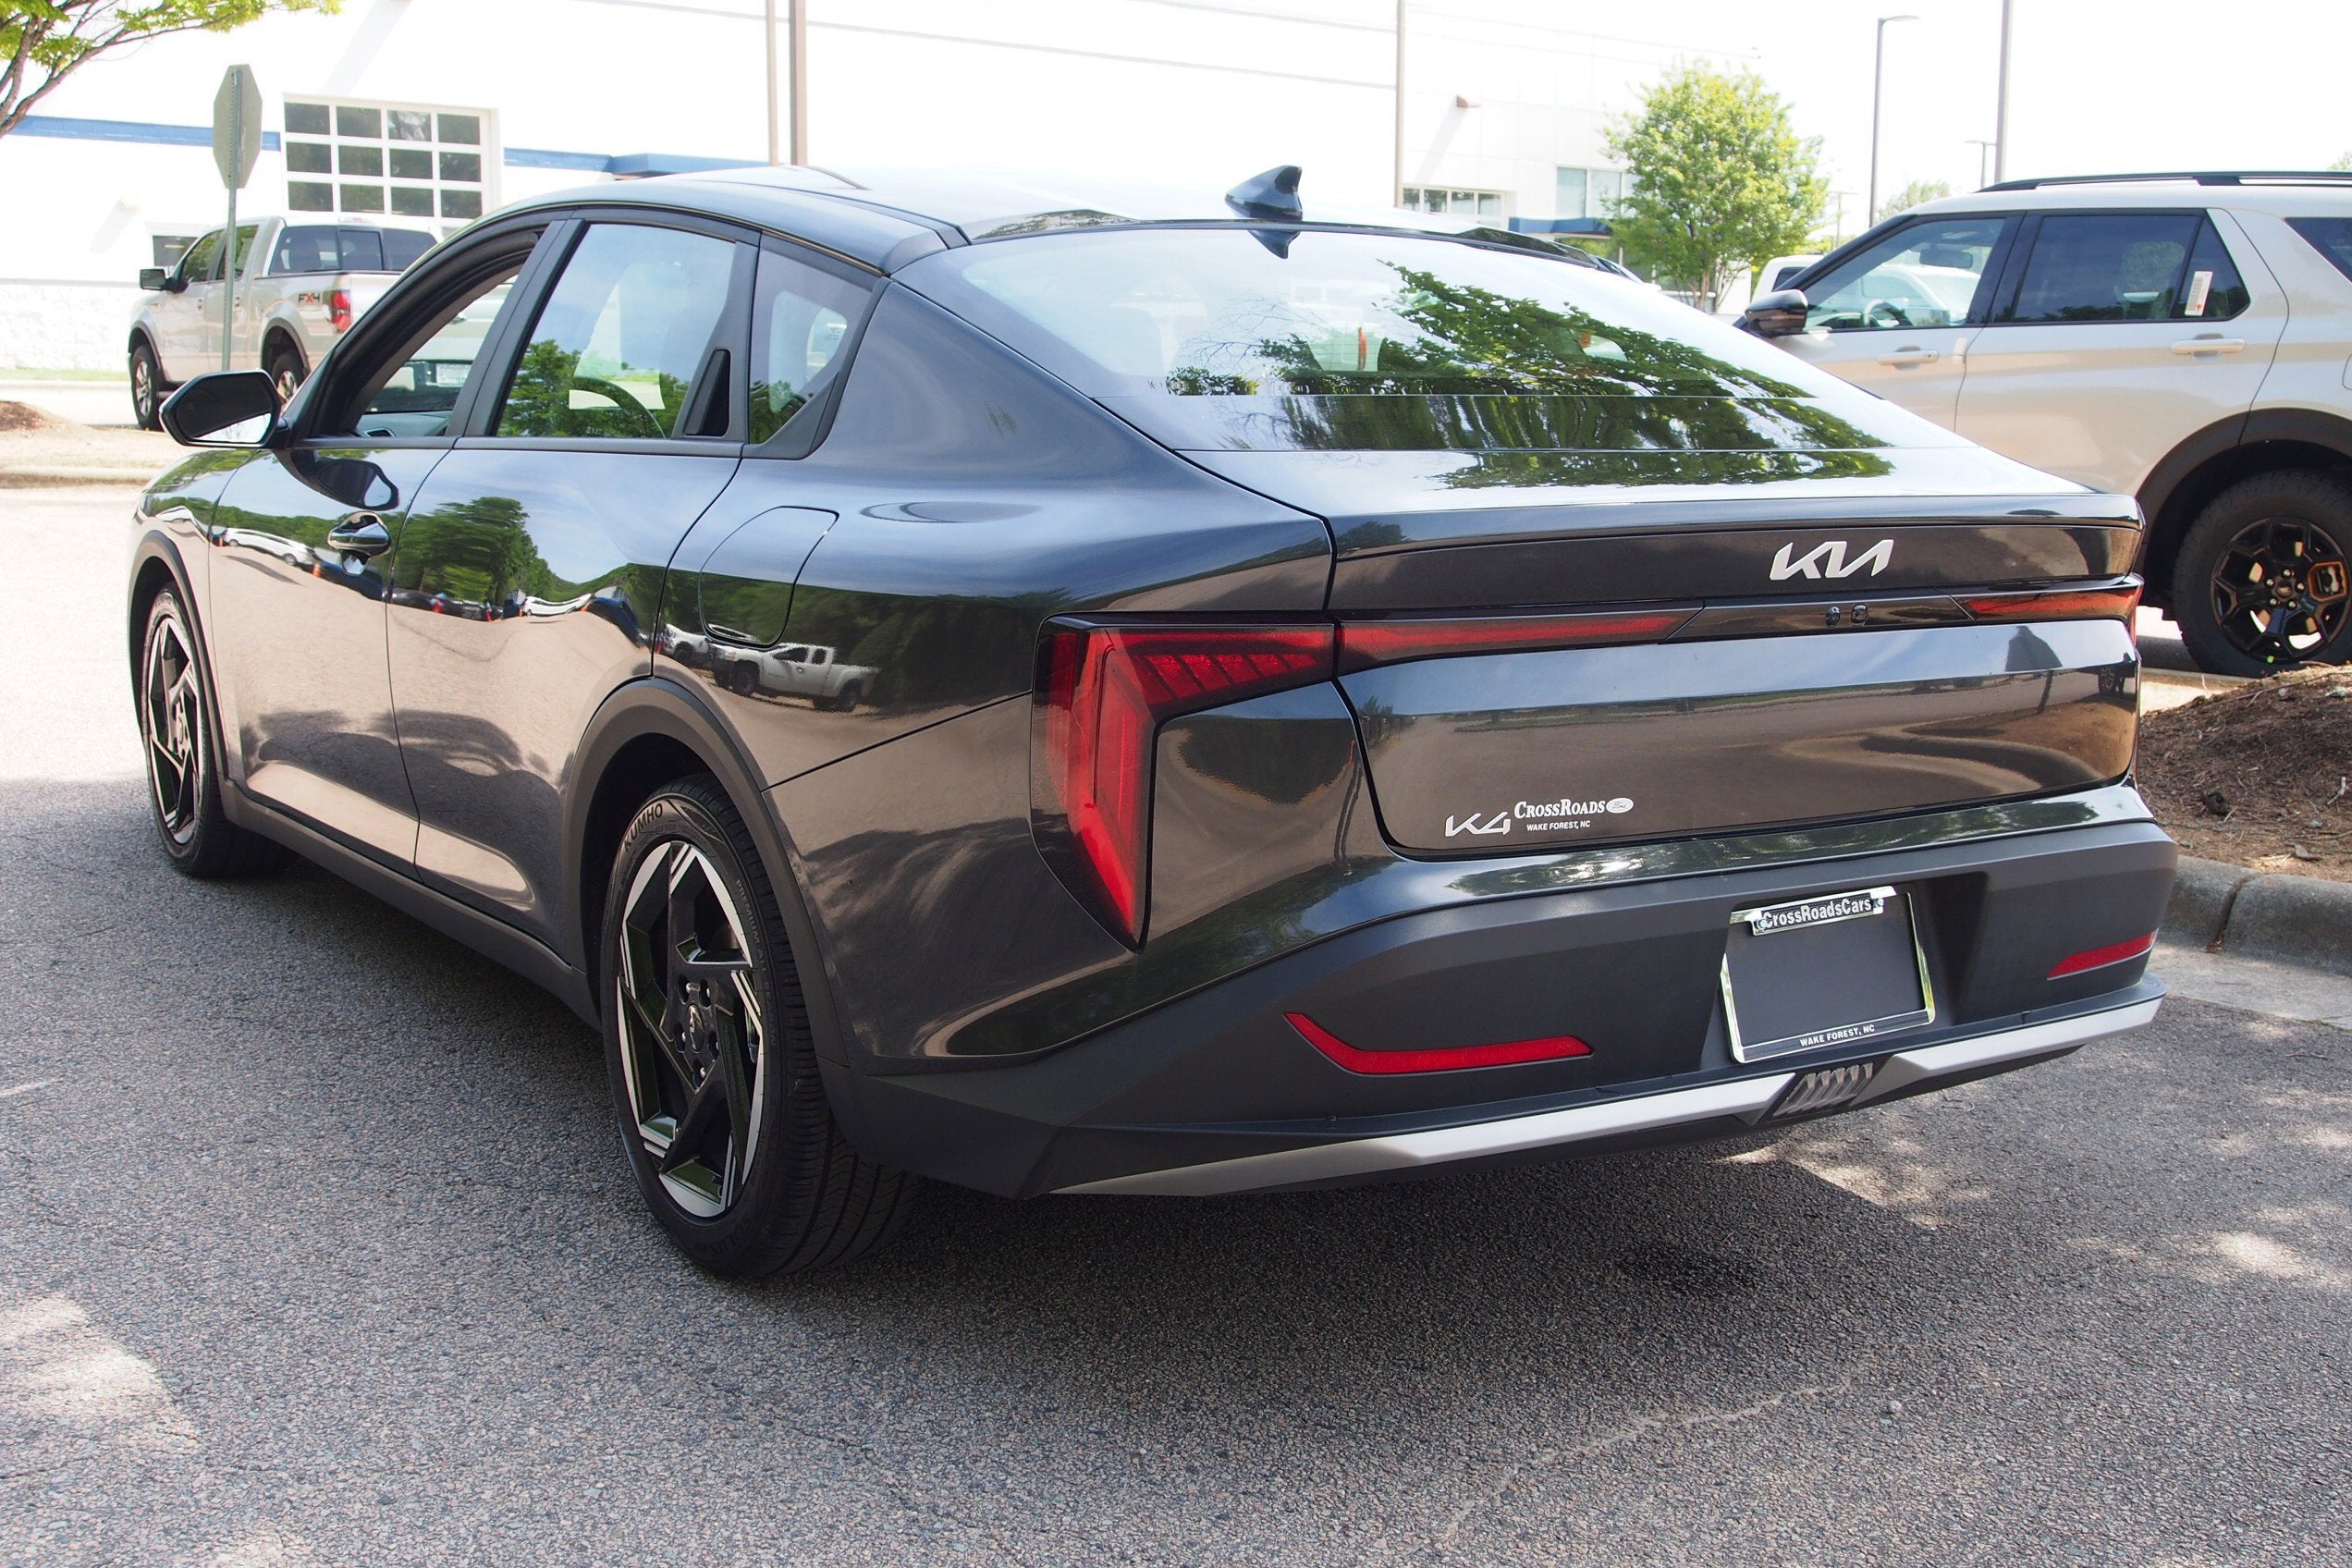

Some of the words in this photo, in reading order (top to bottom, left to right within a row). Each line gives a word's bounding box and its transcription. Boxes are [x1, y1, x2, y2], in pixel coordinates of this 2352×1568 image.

[298, 292, 321, 303] FX4
[1769, 538, 1894, 581] KIA
[623, 802, 663, 852] KUMHO
[1444, 811, 1511, 838] K4
[1526, 822, 1549, 832] WAKE
[1549, 820, 1579, 831] FOREST,
[1579, 819, 1591, 829] NC
[1762, 897, 1872, 929] CrossRoadsCars
[1799, 1035, 1825, 1047] WAKE
[1826, 1026, 1862, 1042] FOREST,
[1862, 1023, 1876, 1034] NC
